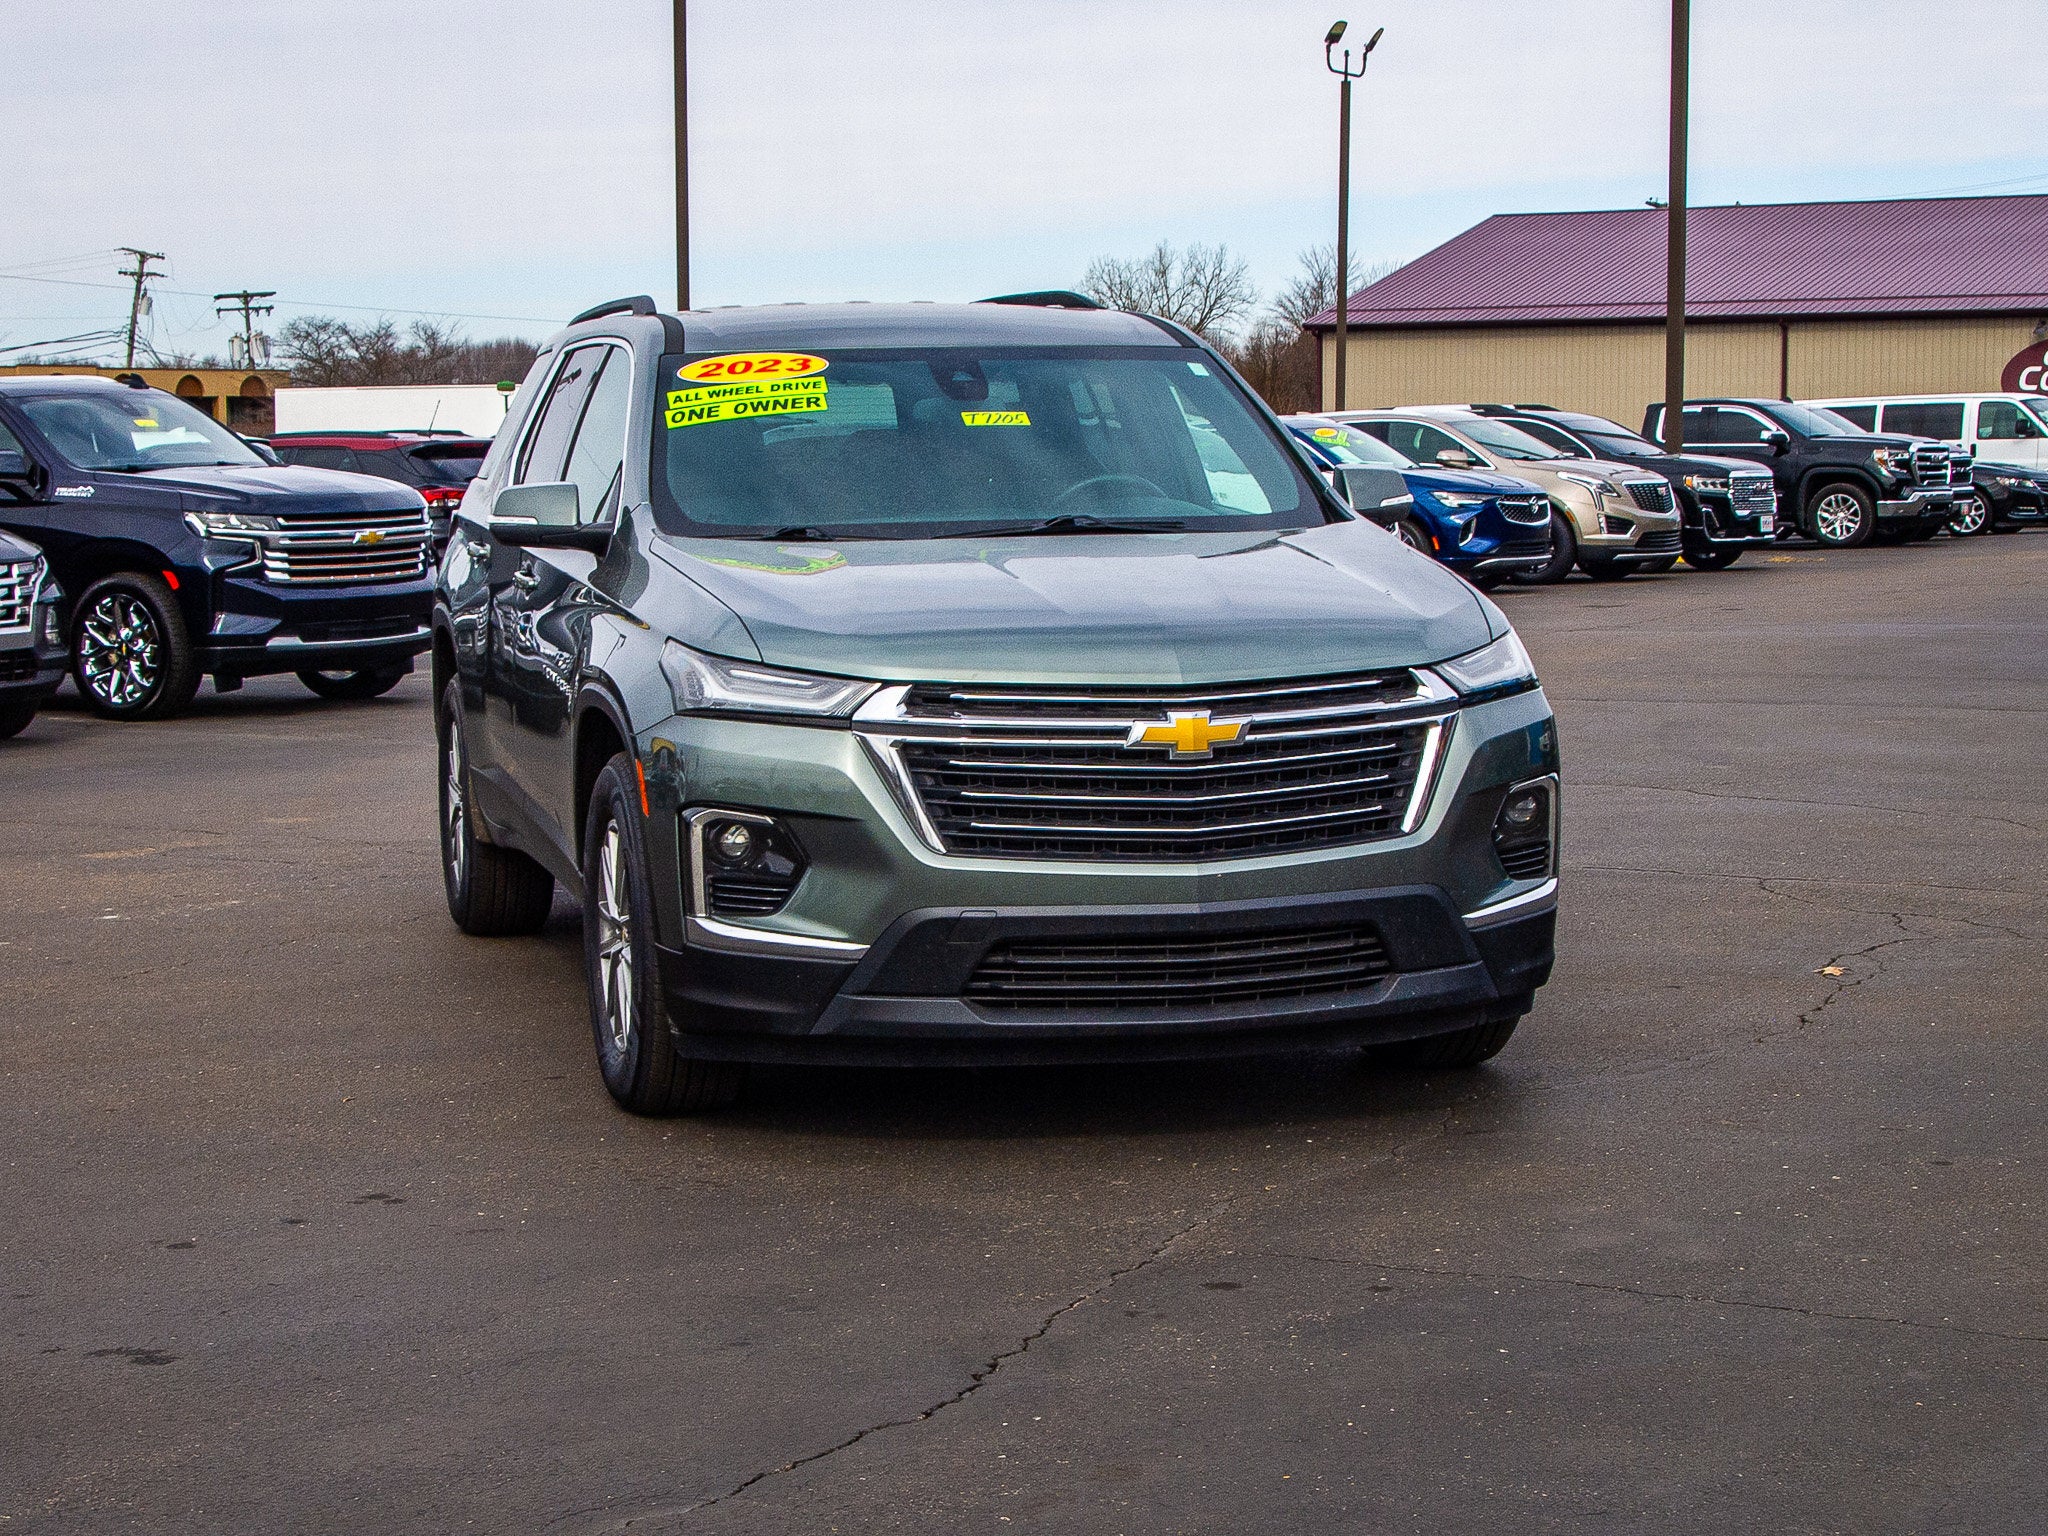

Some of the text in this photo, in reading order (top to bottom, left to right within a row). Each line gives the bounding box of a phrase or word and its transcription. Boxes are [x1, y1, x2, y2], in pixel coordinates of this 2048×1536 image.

[696, 358, 812, 378] 2023
[672, 380, 822, 404] ALL WHEEL DRIVE
[671, 396, 822, 424] ONE OWNER
